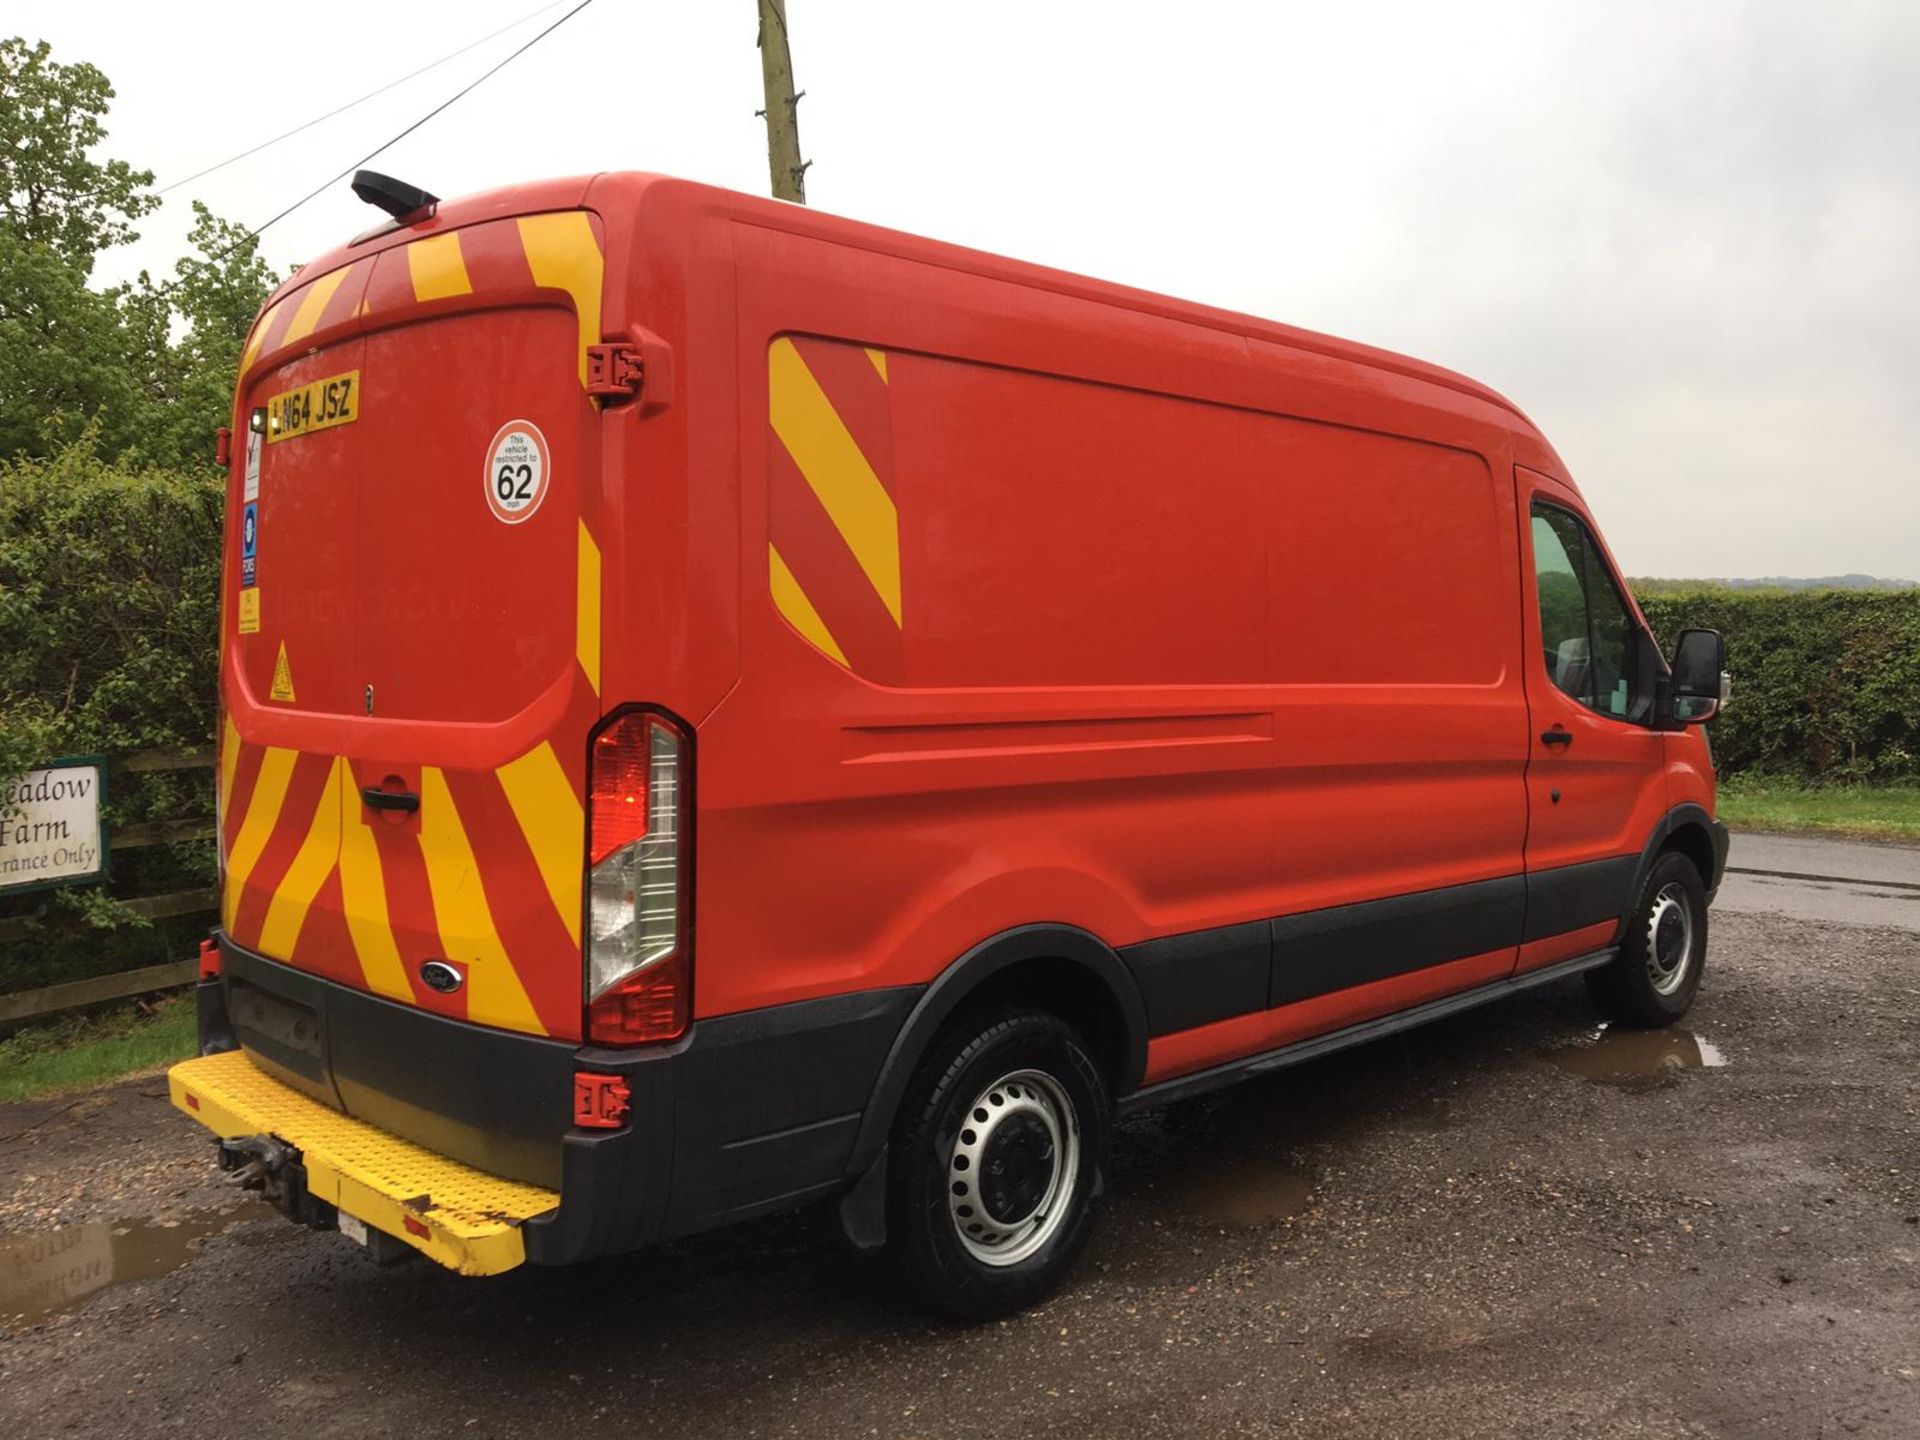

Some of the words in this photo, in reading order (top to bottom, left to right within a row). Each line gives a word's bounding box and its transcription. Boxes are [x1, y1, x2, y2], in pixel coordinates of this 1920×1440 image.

[272, 391, 311, 435] LN64
[316, 378, 352, 422] JSZ
[505, 445, 528, 454] vehicle
[510, 435, 524, 444] This
[495, 454, 527, 464] restricted
[529, 454, 538, 463] to
[497, 464, 533, 501] 62
[4, 771, 91, 805] eadow
[0, 820, 70, 847] Farm
[53, 842, 96, 870] Only
